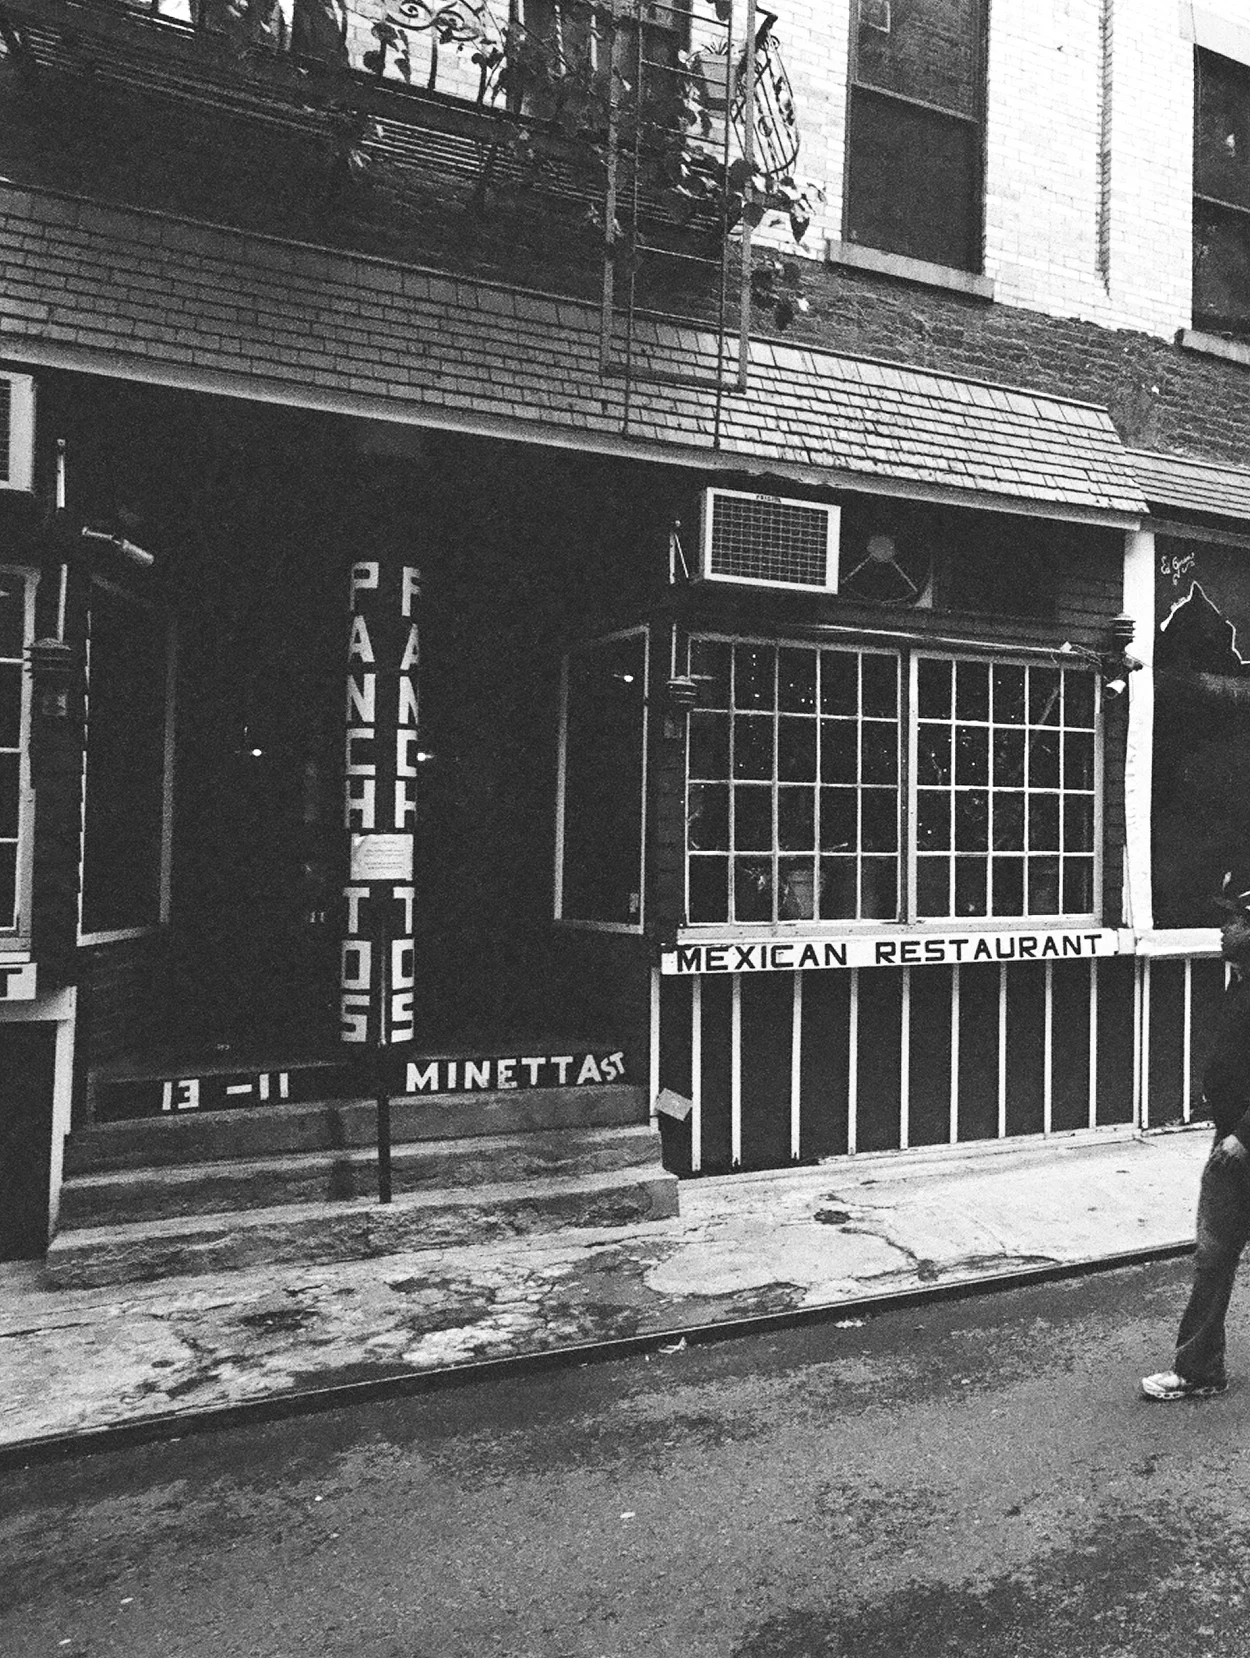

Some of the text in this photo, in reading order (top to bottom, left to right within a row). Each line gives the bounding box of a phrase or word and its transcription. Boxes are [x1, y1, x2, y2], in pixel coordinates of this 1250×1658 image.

[341, 561, 379, 1042] PANCHTOS
[677, 934, 1102, 972] MEXICAN RESTAURANT
[162, 1081, 200, 1110] 13
[406, 1054, 602, 1092] MINETTA
